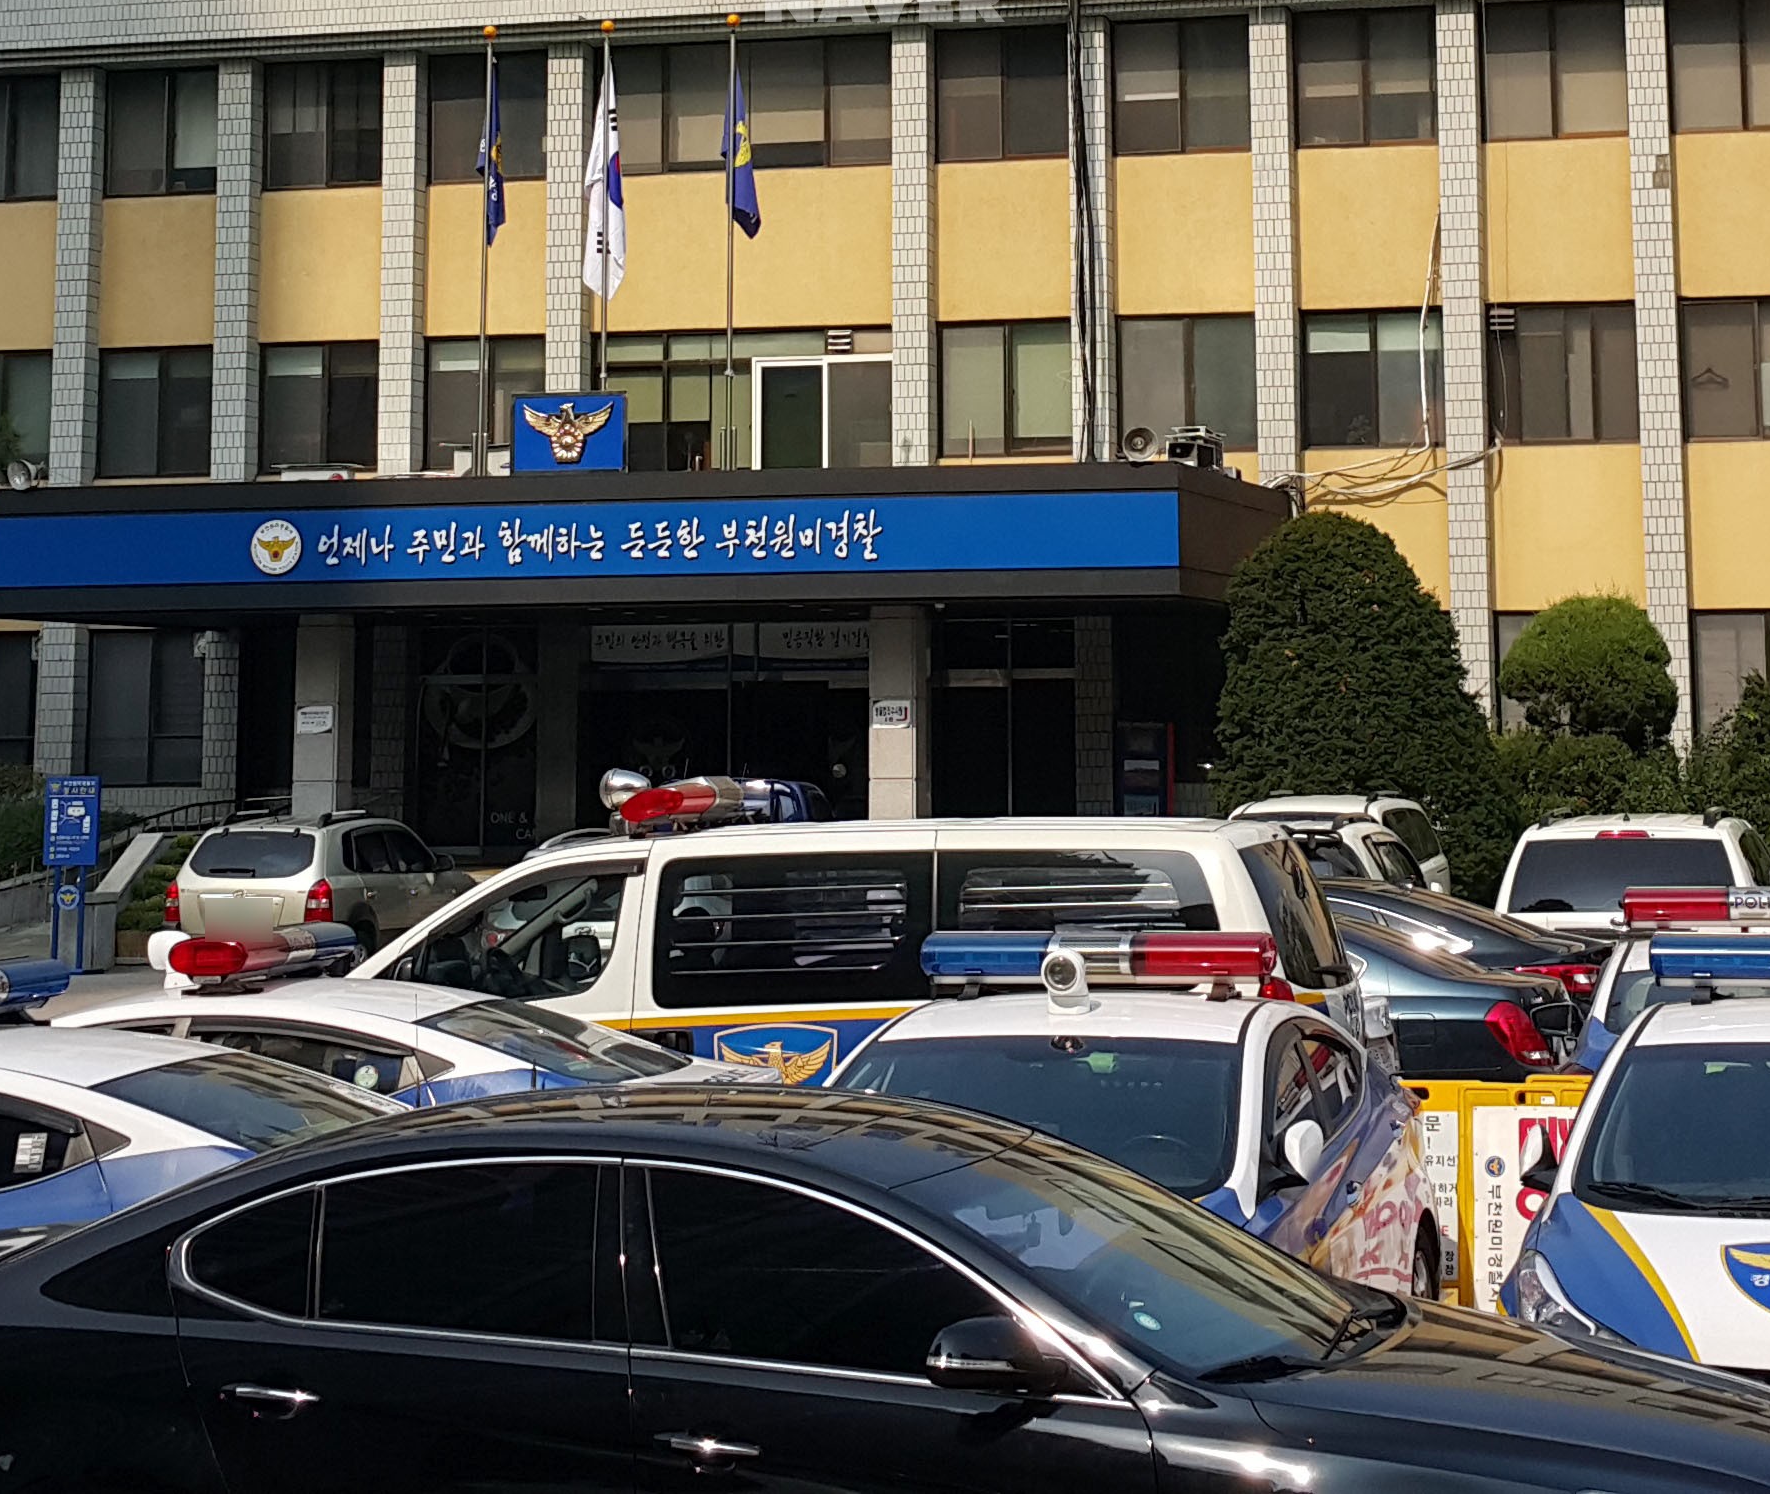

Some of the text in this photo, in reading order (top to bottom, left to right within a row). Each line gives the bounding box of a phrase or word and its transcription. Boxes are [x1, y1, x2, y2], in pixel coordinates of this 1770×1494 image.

[317, 524, 394, 566] 언제나
[406, 521, 485, 565] 주민과
[498, 517, 605, 565] 함께하는
[620, 516, 705, 559] 든든한
[715, 508, 882, 560] 부천원미경찰
